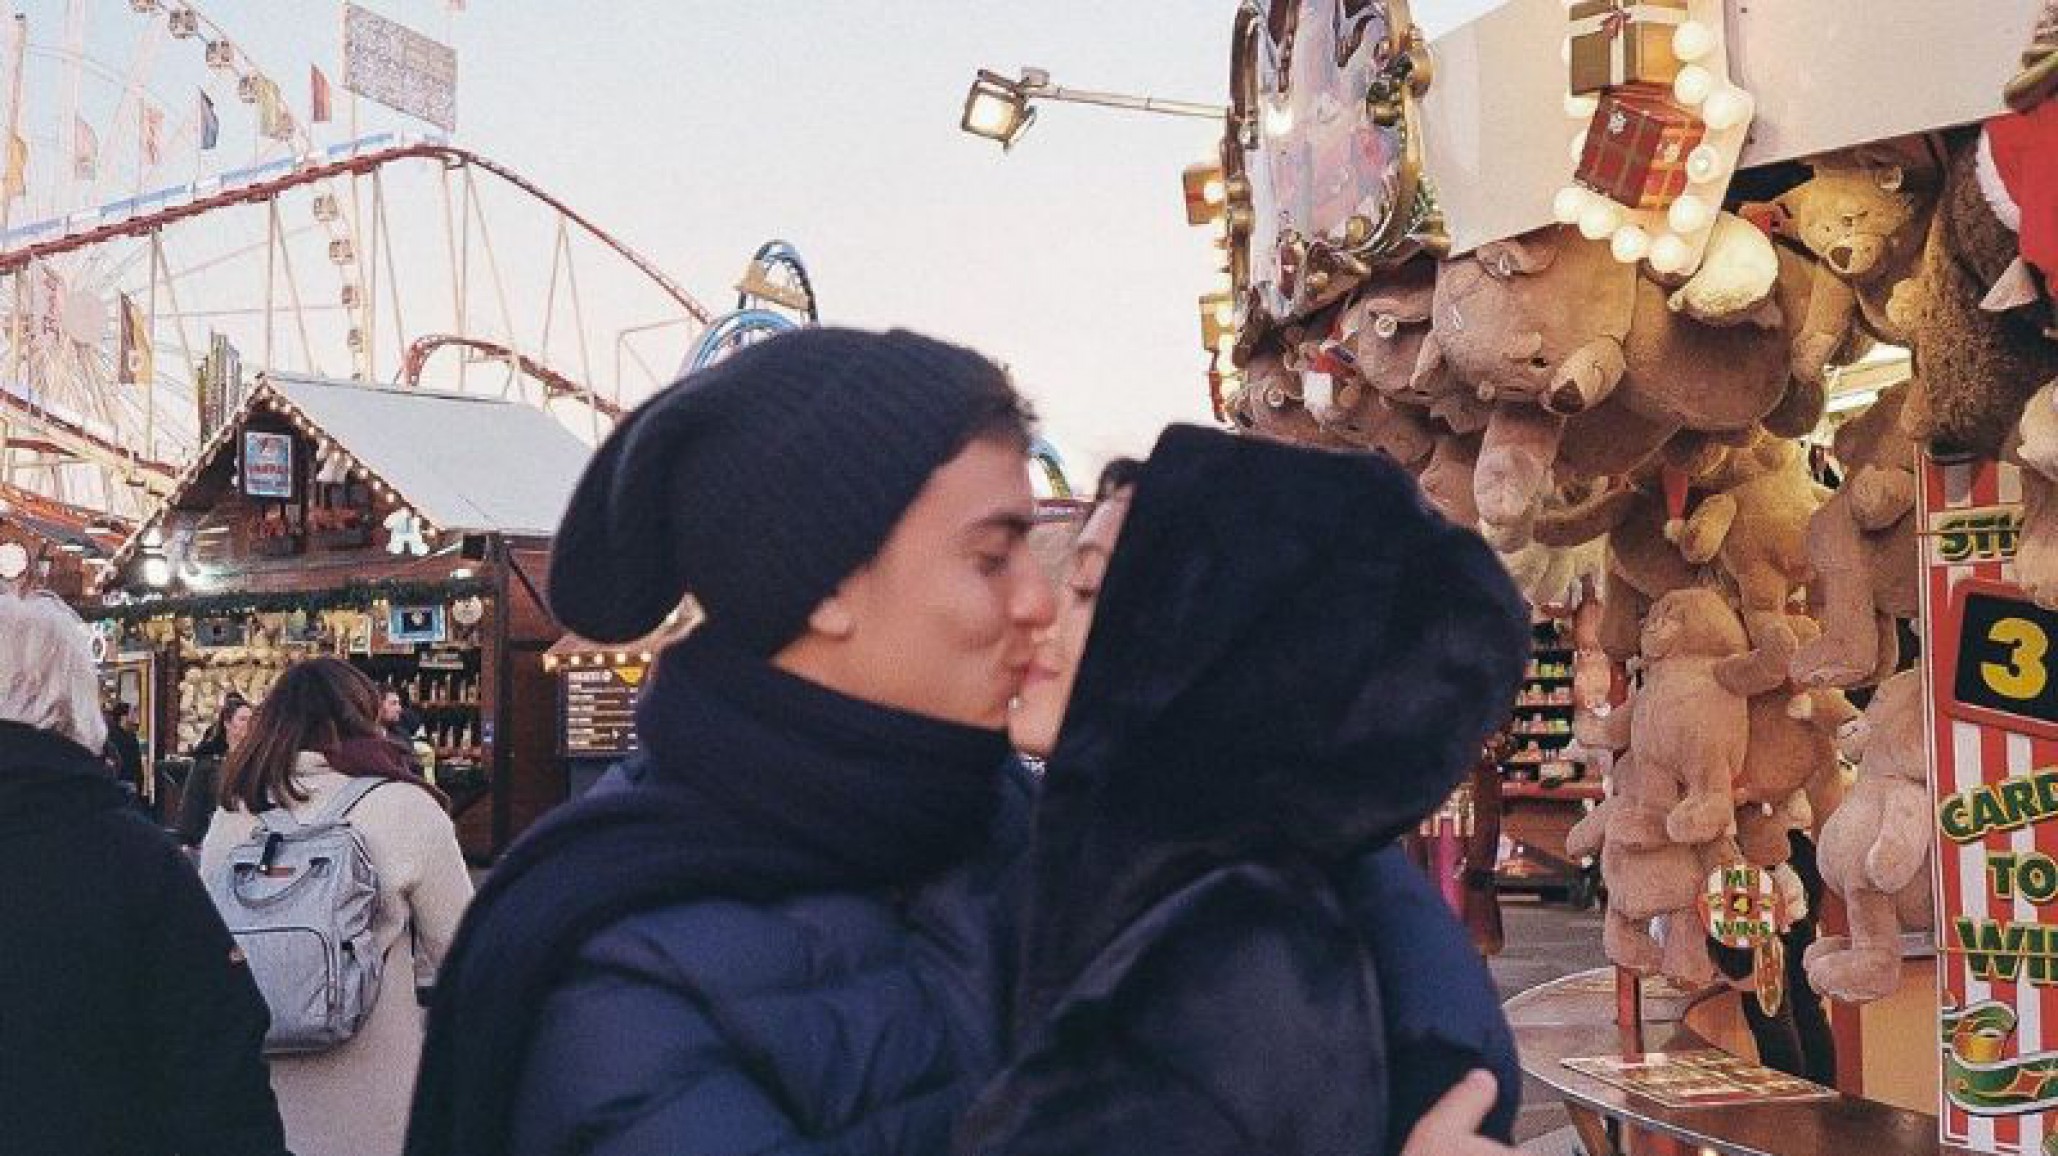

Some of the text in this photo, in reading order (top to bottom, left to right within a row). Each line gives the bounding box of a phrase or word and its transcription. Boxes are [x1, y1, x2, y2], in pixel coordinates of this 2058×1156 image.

[1939, 513, 2023, 560] STI
[1980, 617, 2048, 699] 3
[1988, 851, 2058, 905] TO
[1732, 895, 1750, 914] 4
[1714, 920, 1771, 937] WINS
